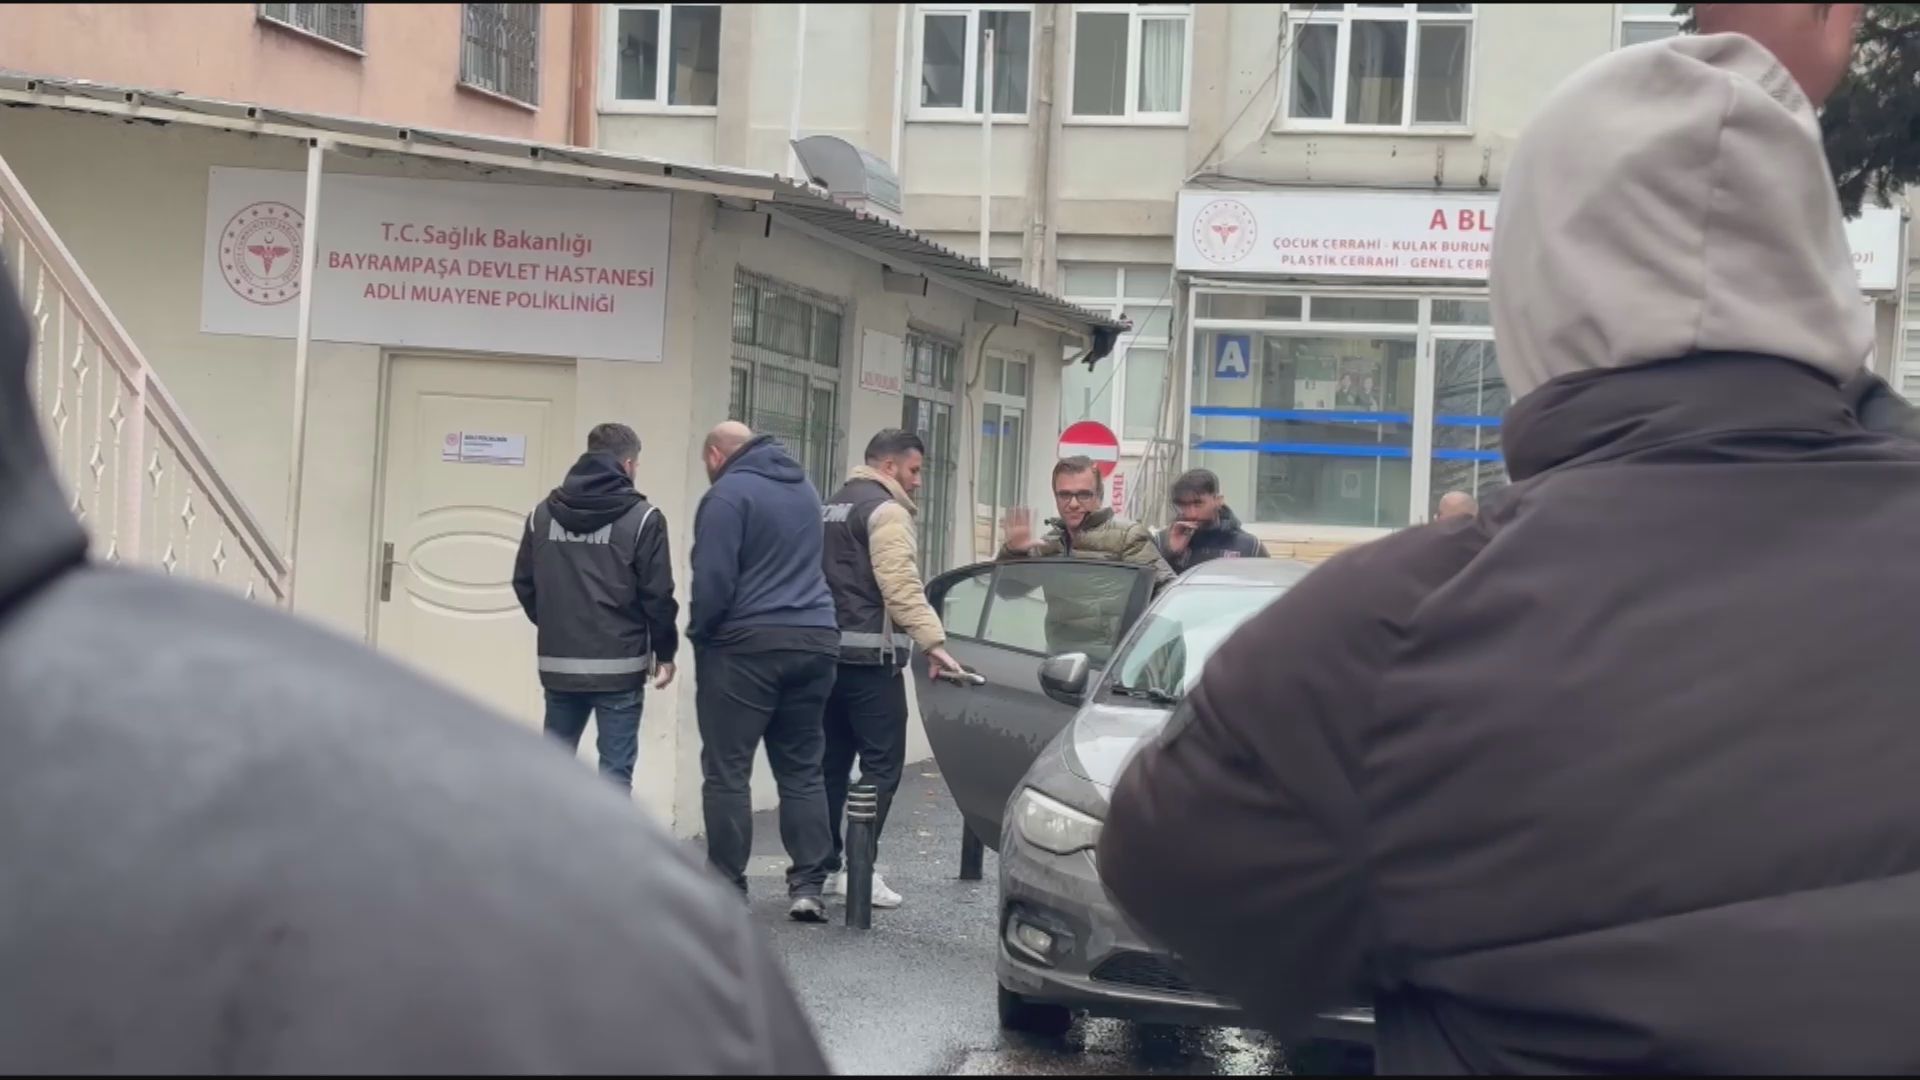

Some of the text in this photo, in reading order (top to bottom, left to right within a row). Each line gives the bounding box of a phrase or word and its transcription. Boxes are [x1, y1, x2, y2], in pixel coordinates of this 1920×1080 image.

[1429, 208, 1448, 231] A
[493, 228, 592, 258] Bakanlığı
[1273, 237, 1490, 253] ÇOCUK CERRAHİ KULAK BURUN
[328, 250, 655, 288] BAYRAMPAŞA DEVLET HASTANESİ
[1281, 254, 1337, 266] PLASTİK
[1340, 255, 1399, 268] CERRAHİ
[1410, 257, 1454, 269] GENEL
[363, 281, 616, 314] ADLİ MUAYENE POLİKLİNİĞİ
[1217, 341, 1247, 373] A
